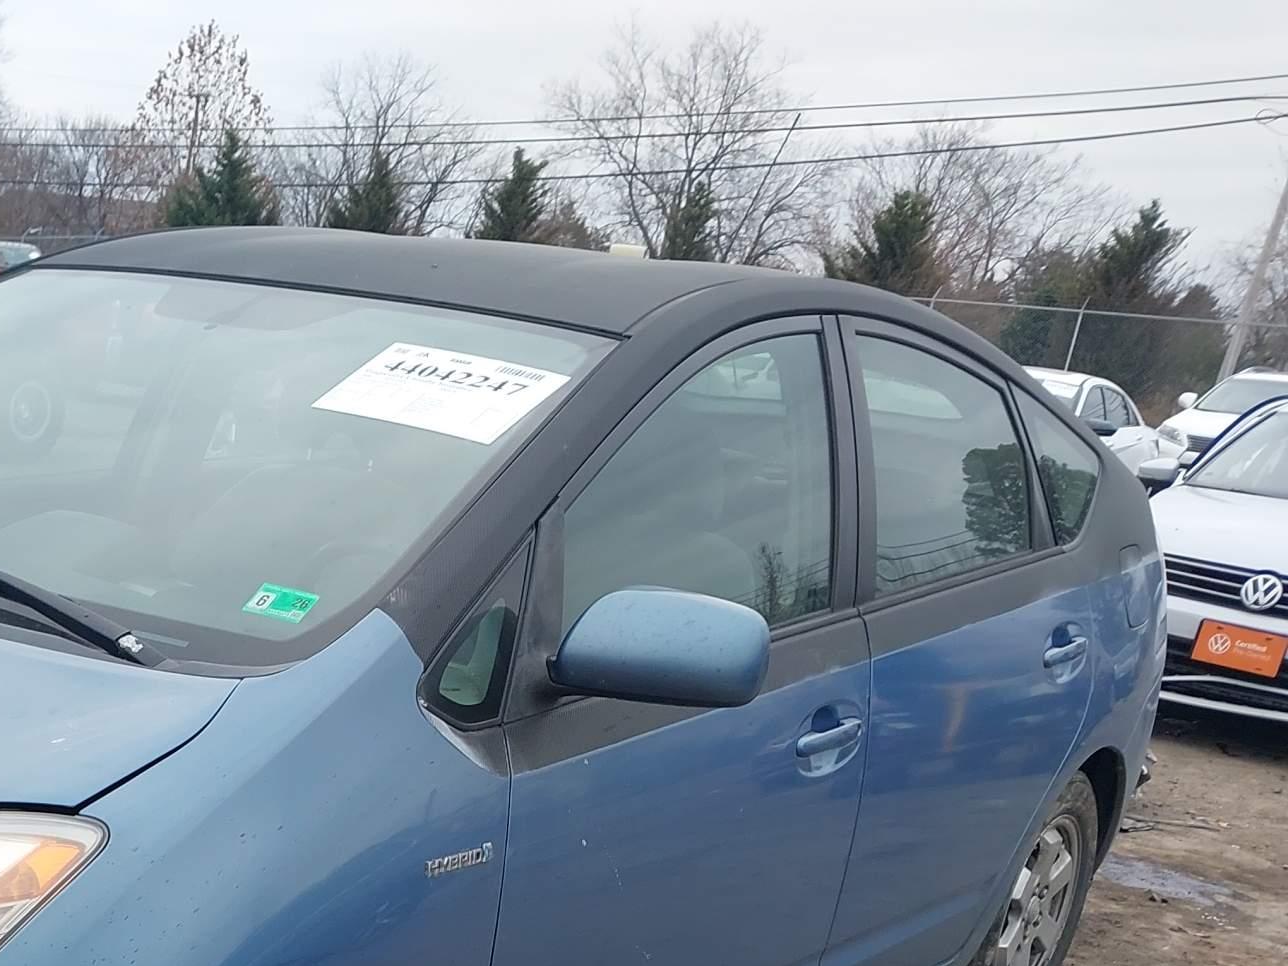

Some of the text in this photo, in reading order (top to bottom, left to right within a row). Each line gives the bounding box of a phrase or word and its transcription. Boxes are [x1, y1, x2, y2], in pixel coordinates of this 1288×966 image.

[383, 360, 529, 395] 44042247
[255, 594, 270, 607] 6
[424, 847, 483, 878] HYBRID
